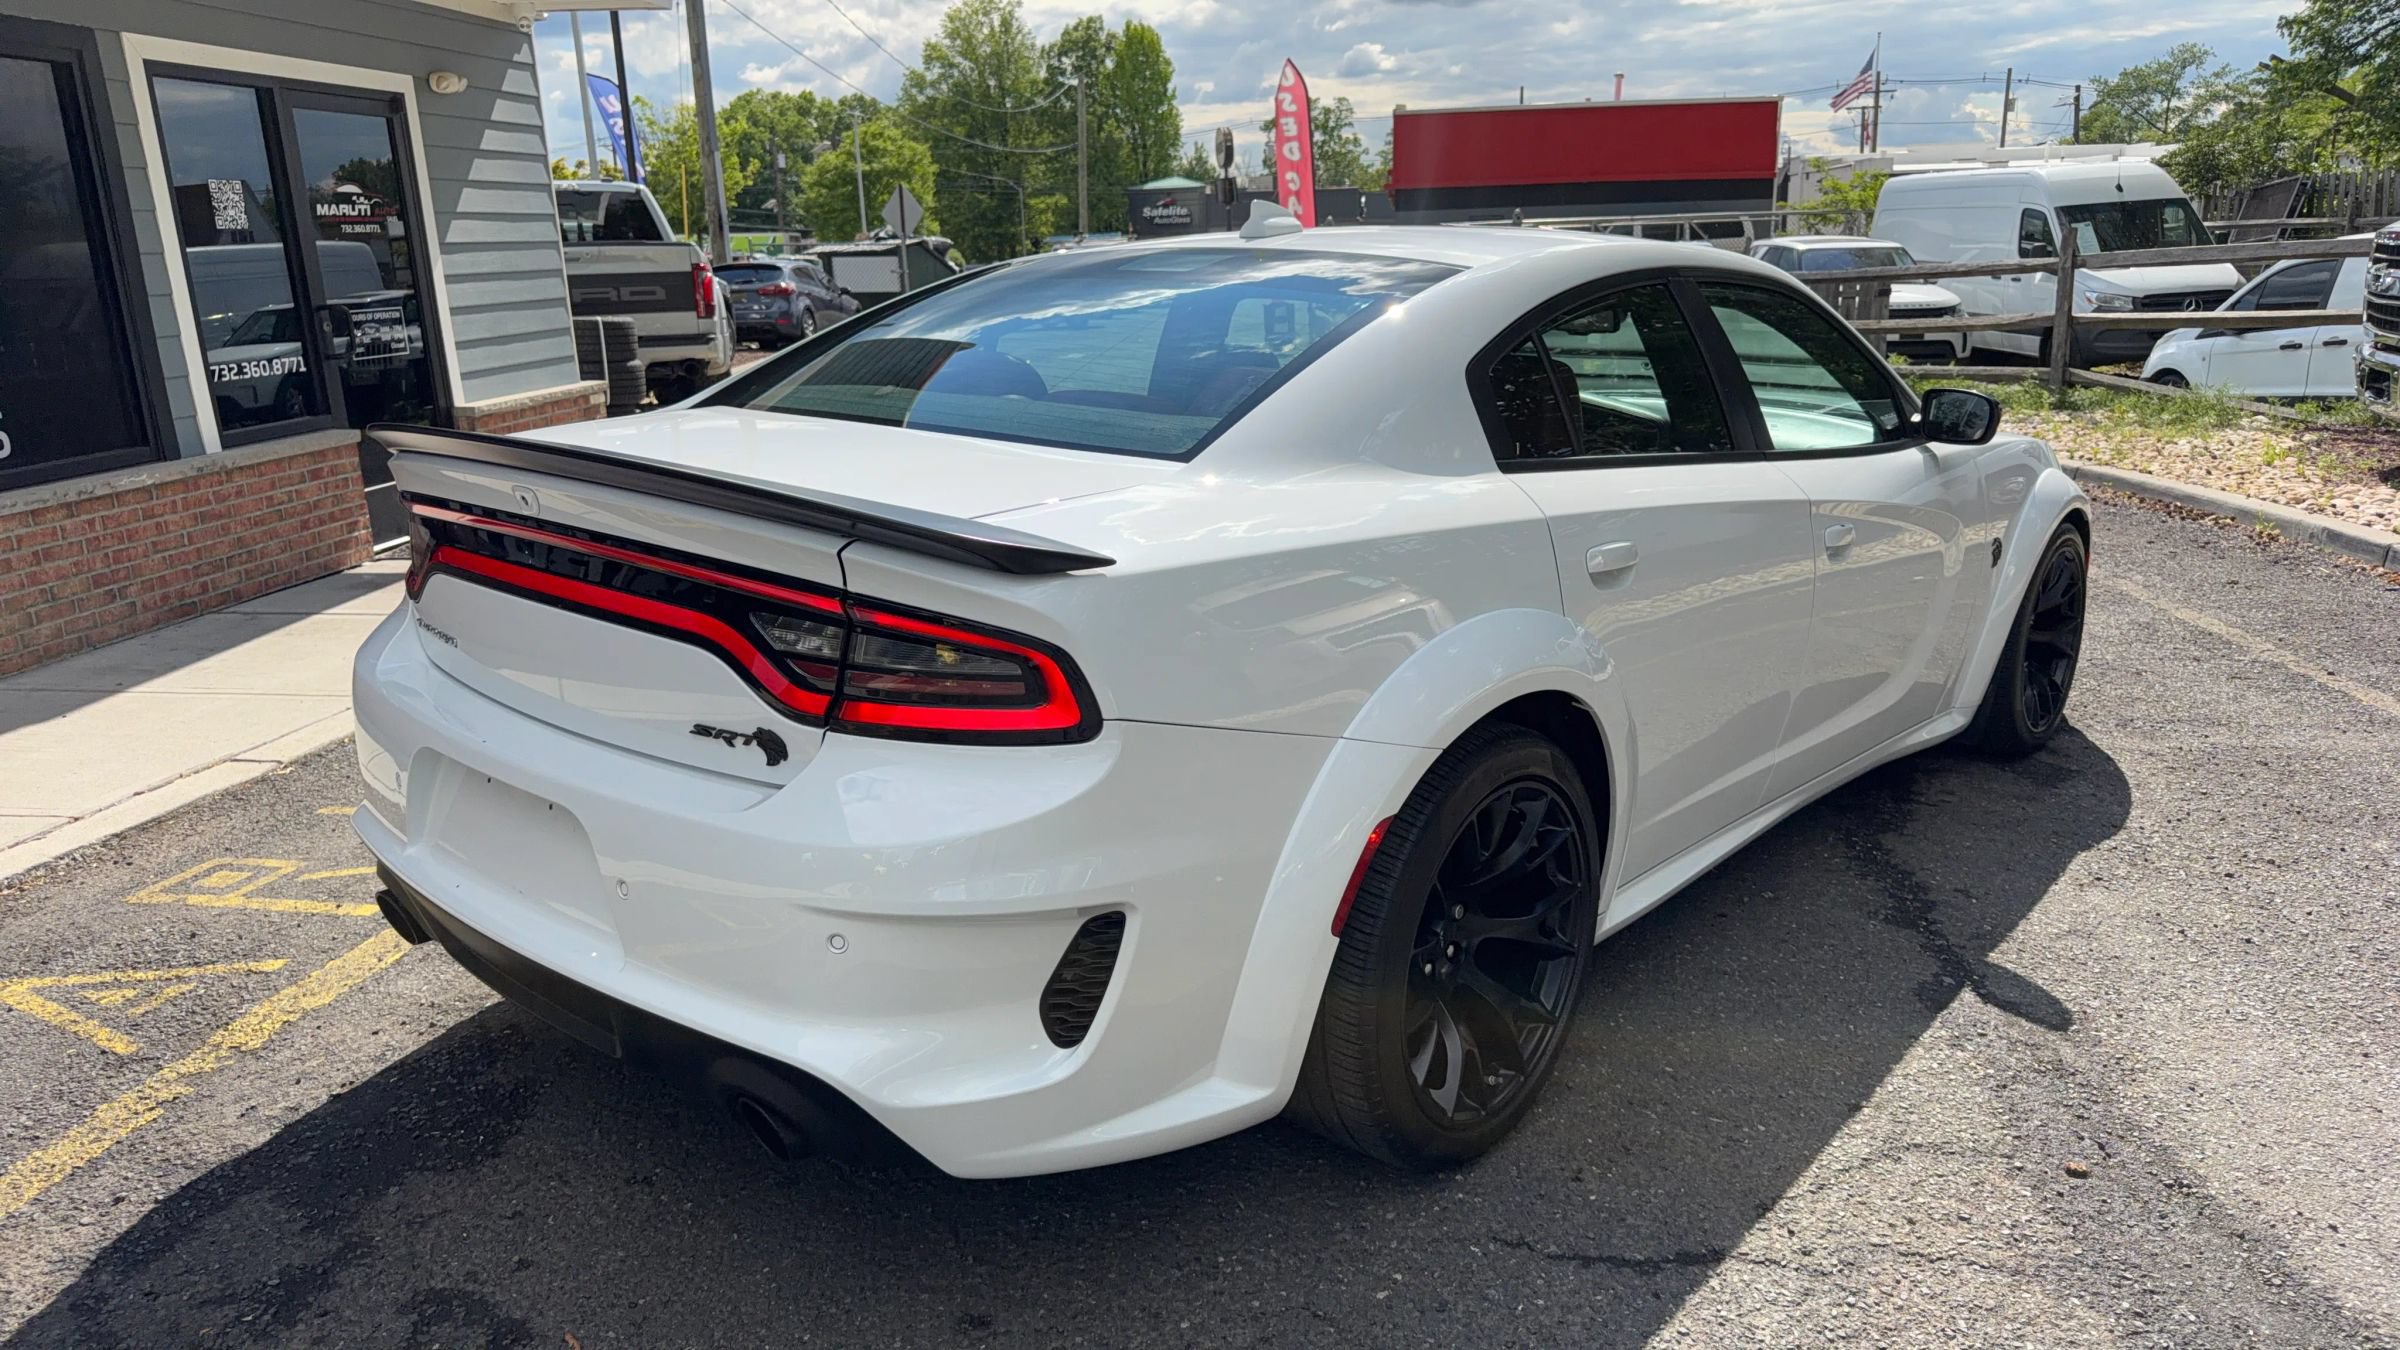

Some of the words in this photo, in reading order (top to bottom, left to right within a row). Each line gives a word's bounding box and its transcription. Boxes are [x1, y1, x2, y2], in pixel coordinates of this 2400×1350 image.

[316, 203, 371, 216] MARUTI
[1142, 205, 1188, 217] Safelite
[340, 224, 381, 233] 732.360.8771
[352, 313, 366, 322] OURS
[373, 311, 401, 320] OPERATION
[209, 355, 307, 383] 732.360.8771
[688, 723, 754, 748] SRT
